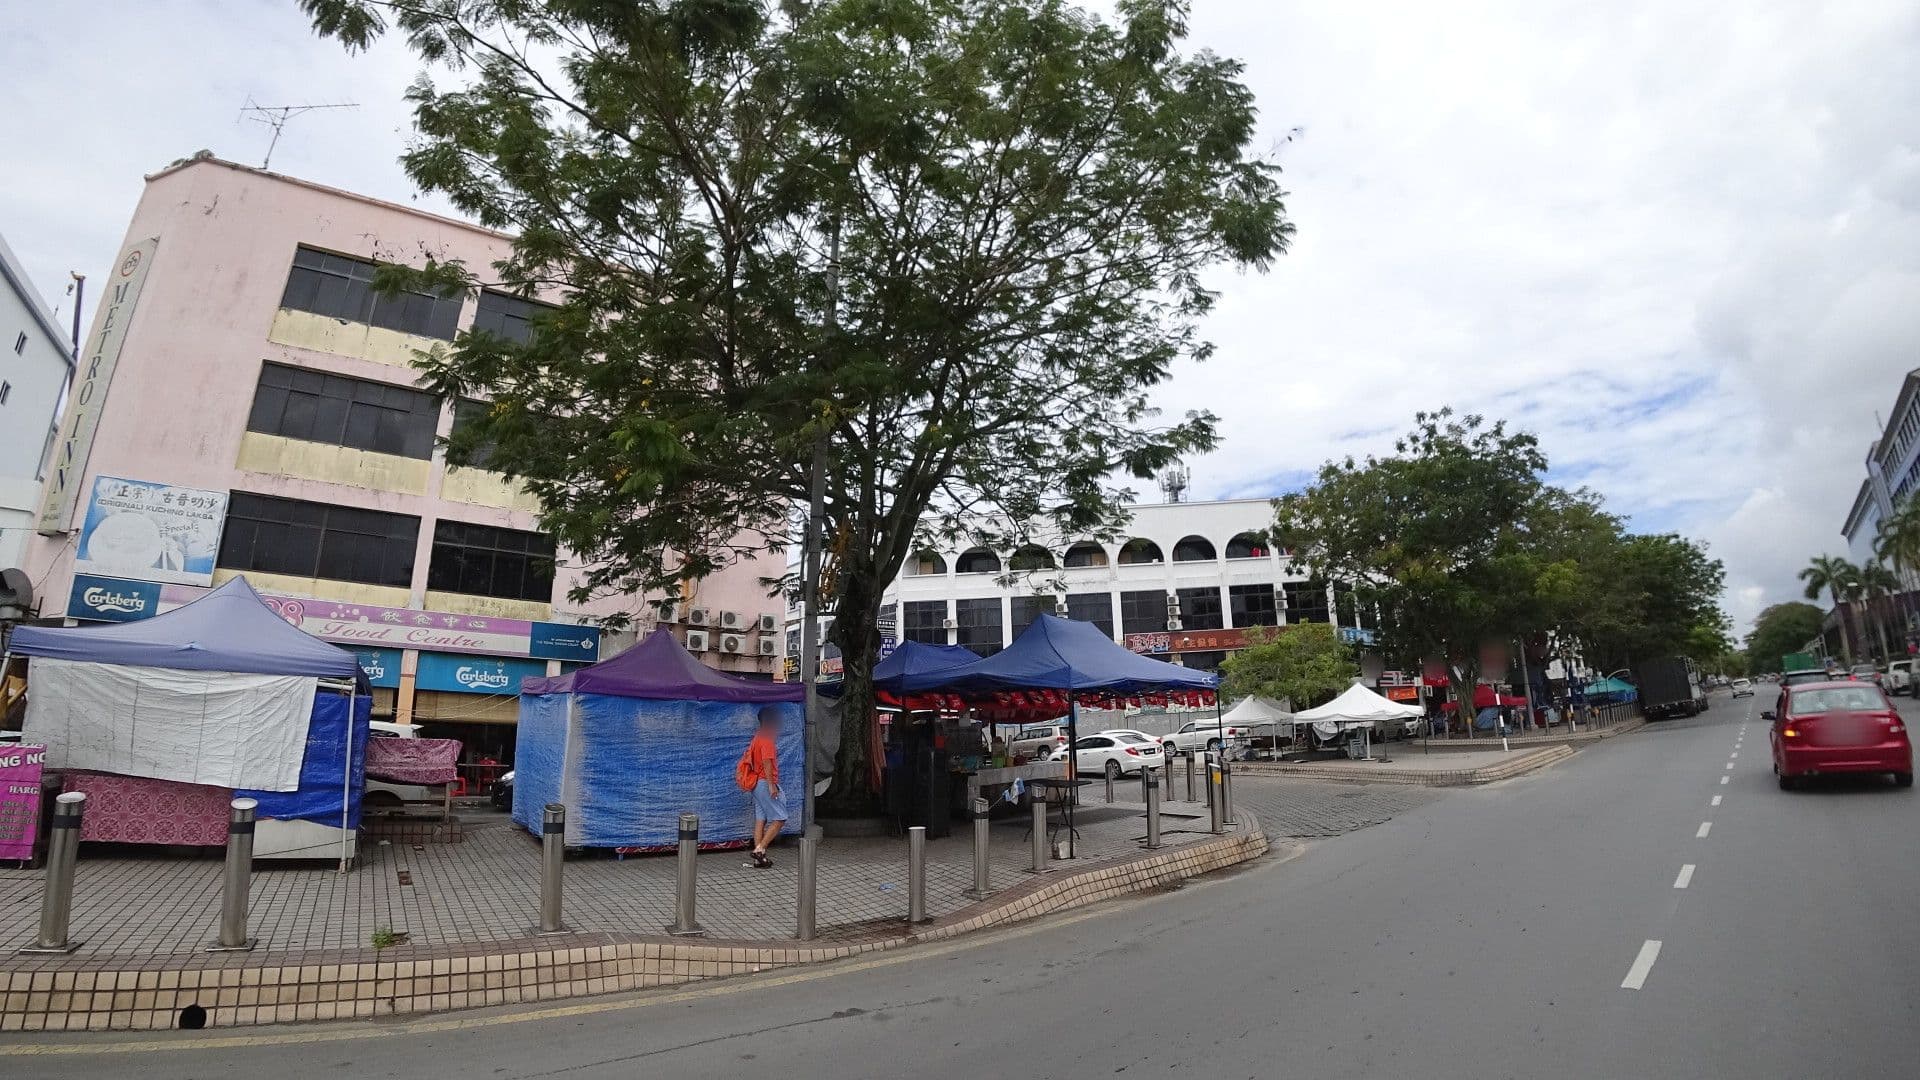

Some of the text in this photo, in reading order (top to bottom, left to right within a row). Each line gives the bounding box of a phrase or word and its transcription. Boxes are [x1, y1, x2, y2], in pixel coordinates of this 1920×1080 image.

[53, 281, 131, 495] METRO INN
[145, 504, 184, 517] KUCHING
[186, 510, 214, 521] LAKSA
[83, 587, 145, 612] Carlsberg
[319, 621, 486, 648] Food Centre
[456, 666, 509, 688] Carlsberg
